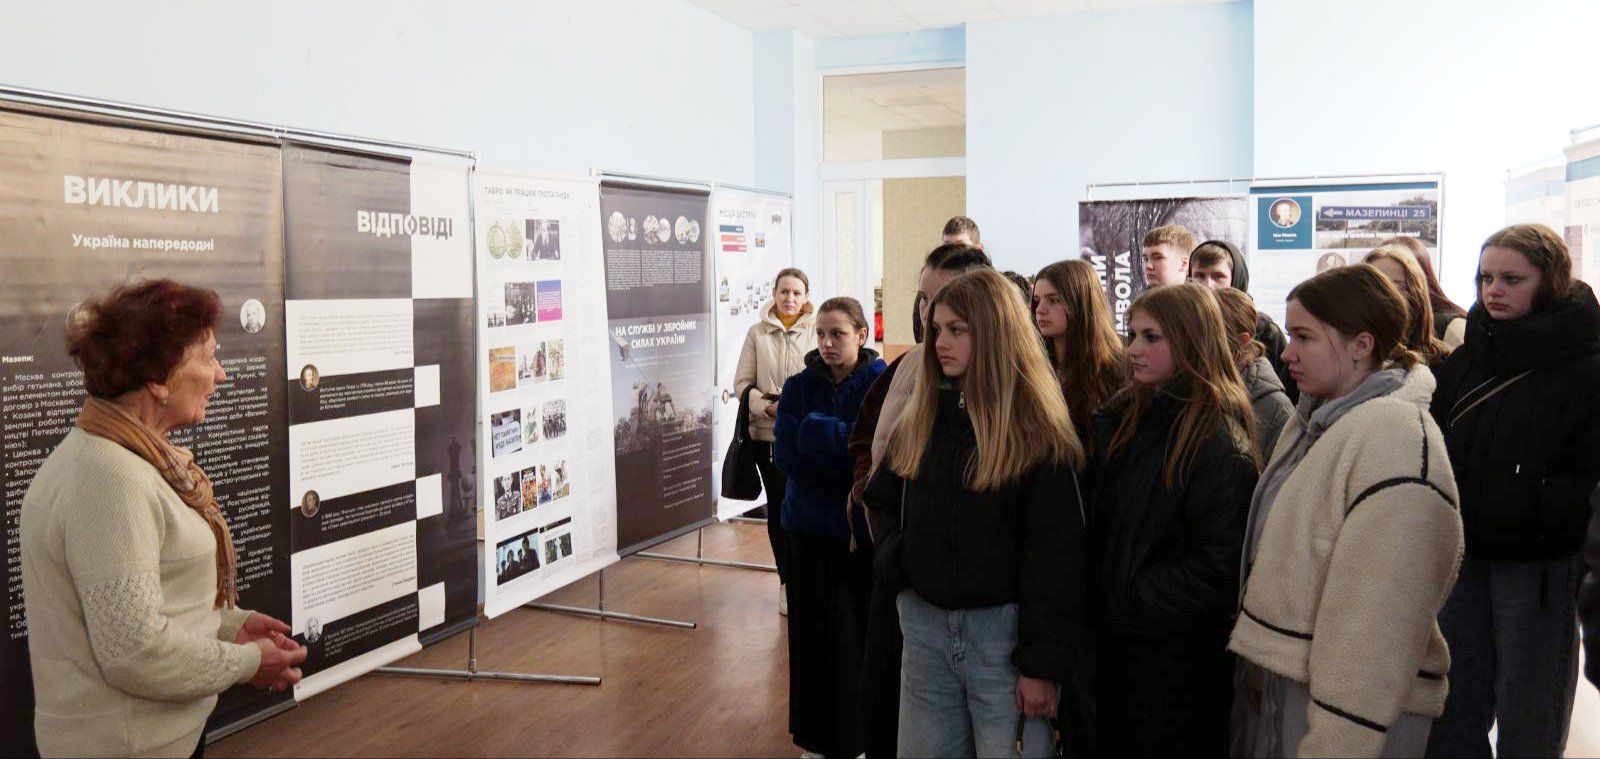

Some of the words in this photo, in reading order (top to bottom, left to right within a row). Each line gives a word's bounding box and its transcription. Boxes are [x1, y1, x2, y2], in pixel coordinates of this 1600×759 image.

[64, 175, 219, 213] ВИКЛИКИ
[1345, 209, 1408, 219] МАЗЕПИНЦІ
[1413, 209, 1426, 218] 25
[357, 210, 453, 240] ВІДПОВІДІ
[72, 234, 130, 250] Україна
[133, 238, 214, 251] напередодні
[615, 327, 627, 337] НА
[628, 324, 656, 336] СЛУЖБІ
[657, 323, 663, 333] У
[664, 320, 697, 332] ЗБРОЙНИХ
[631, 337, 655, 349] СИЛАХ
[656, 333, 686, 347] УКРАЇНИ
[2, 356, 34, 364] Мазепи:
[15, 374, 44, 382] Москва
[51, 370, 85, 379] контрол
[3, 384, 25, 393] вибір
[27, 382, 63, 390] гетьмана,
[65, 379, 86, 387] обов
[19, 391, 61, 400] елементом
[3, 402, 33, 412] договір
[12, 411, 42, 420] Козаків
[4, 421, 34, 431] земляні
[38, 419, 66, 427] роботи
[12, 448, 42, 458] Церква
